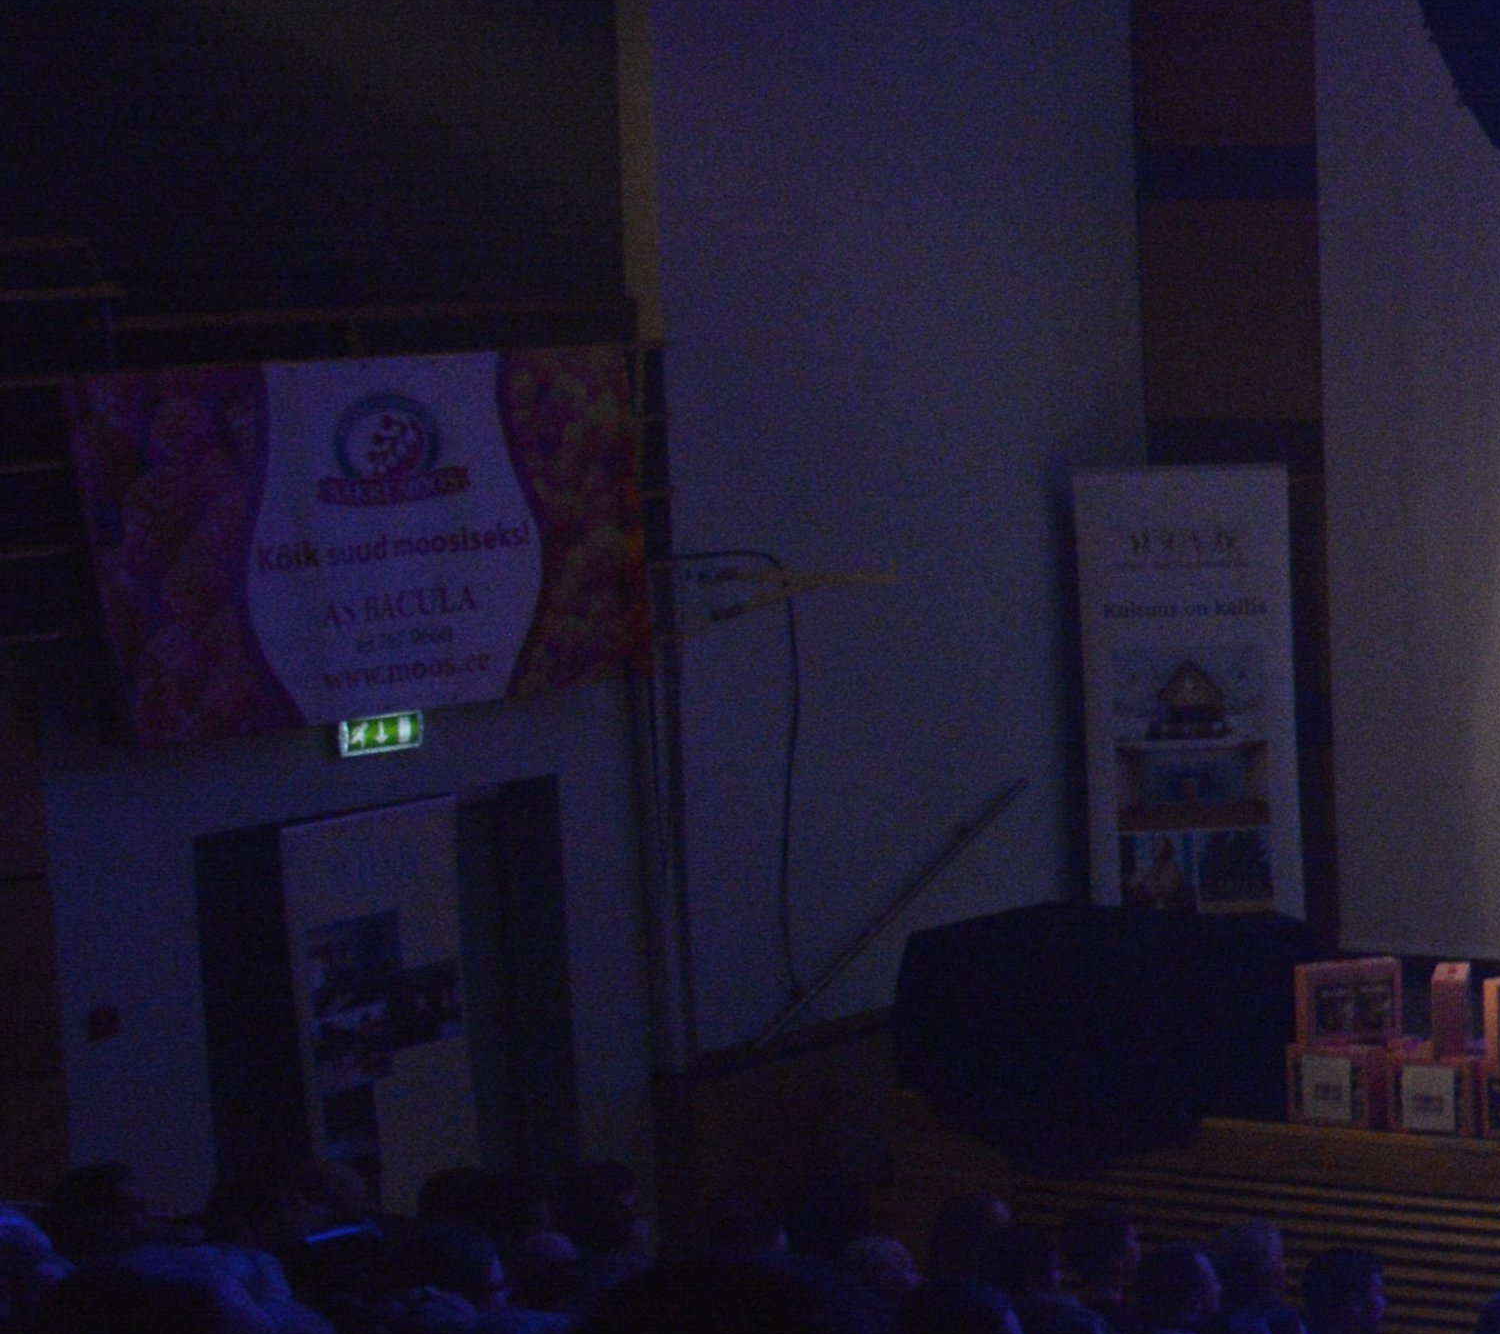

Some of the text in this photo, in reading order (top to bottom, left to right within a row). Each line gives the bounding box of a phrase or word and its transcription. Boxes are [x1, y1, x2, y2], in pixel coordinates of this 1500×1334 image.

[326, 532, 389, 566] suud
[392, 520, 531, 558] moosiseks!
[322, 652, 491, 689] www.moos.ee
